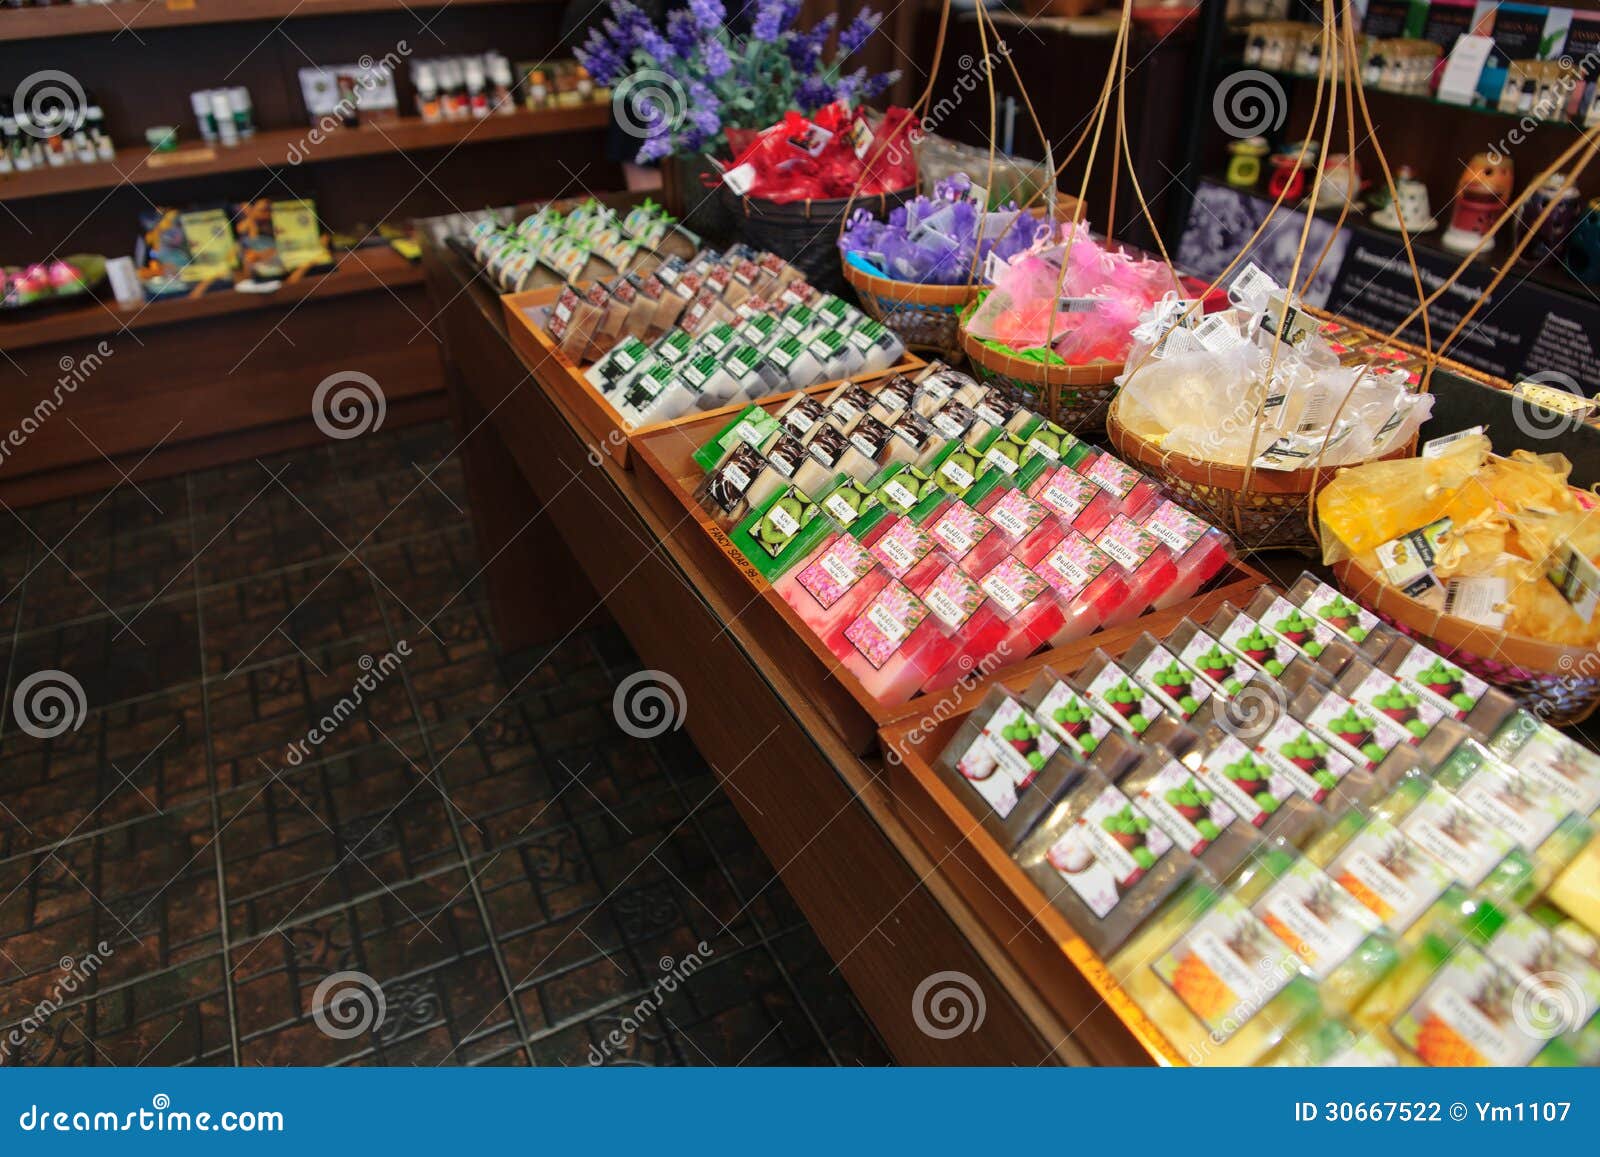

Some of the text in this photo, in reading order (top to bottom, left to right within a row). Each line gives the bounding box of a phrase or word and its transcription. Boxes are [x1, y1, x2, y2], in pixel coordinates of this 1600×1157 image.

[951, 466, 965, 479] Kiwi
[995, 454, 1009, 467] Kiwi
[894, 486, 908, 499] Kiwi
[1048, 487, 1074, 510] Buddleja
[836, 500, 849, 513] Kiwi
[778, 512, 792, 526] Kiwi
[996, 507, 1021, 531] Buddleja
[942, 521, 967, 545] Buddleja
[1151, 522, 1180, 545] Buddleja
[707, 524, 731, 549] FANCY
[727, 546, 749, 569] SOAP
[885, 538, 910, 562] Buddleja
[1104, 537, 1132, 562] Buddleja
[826, 555, 851, 579] Buddleja
[1055, 554, 1082, 579] Buddleja
[989, 578, 1016, 603] Buddleja
[931, 590, 959, 617] Buddleja
[873, 608, 899, 633] Buddleja
